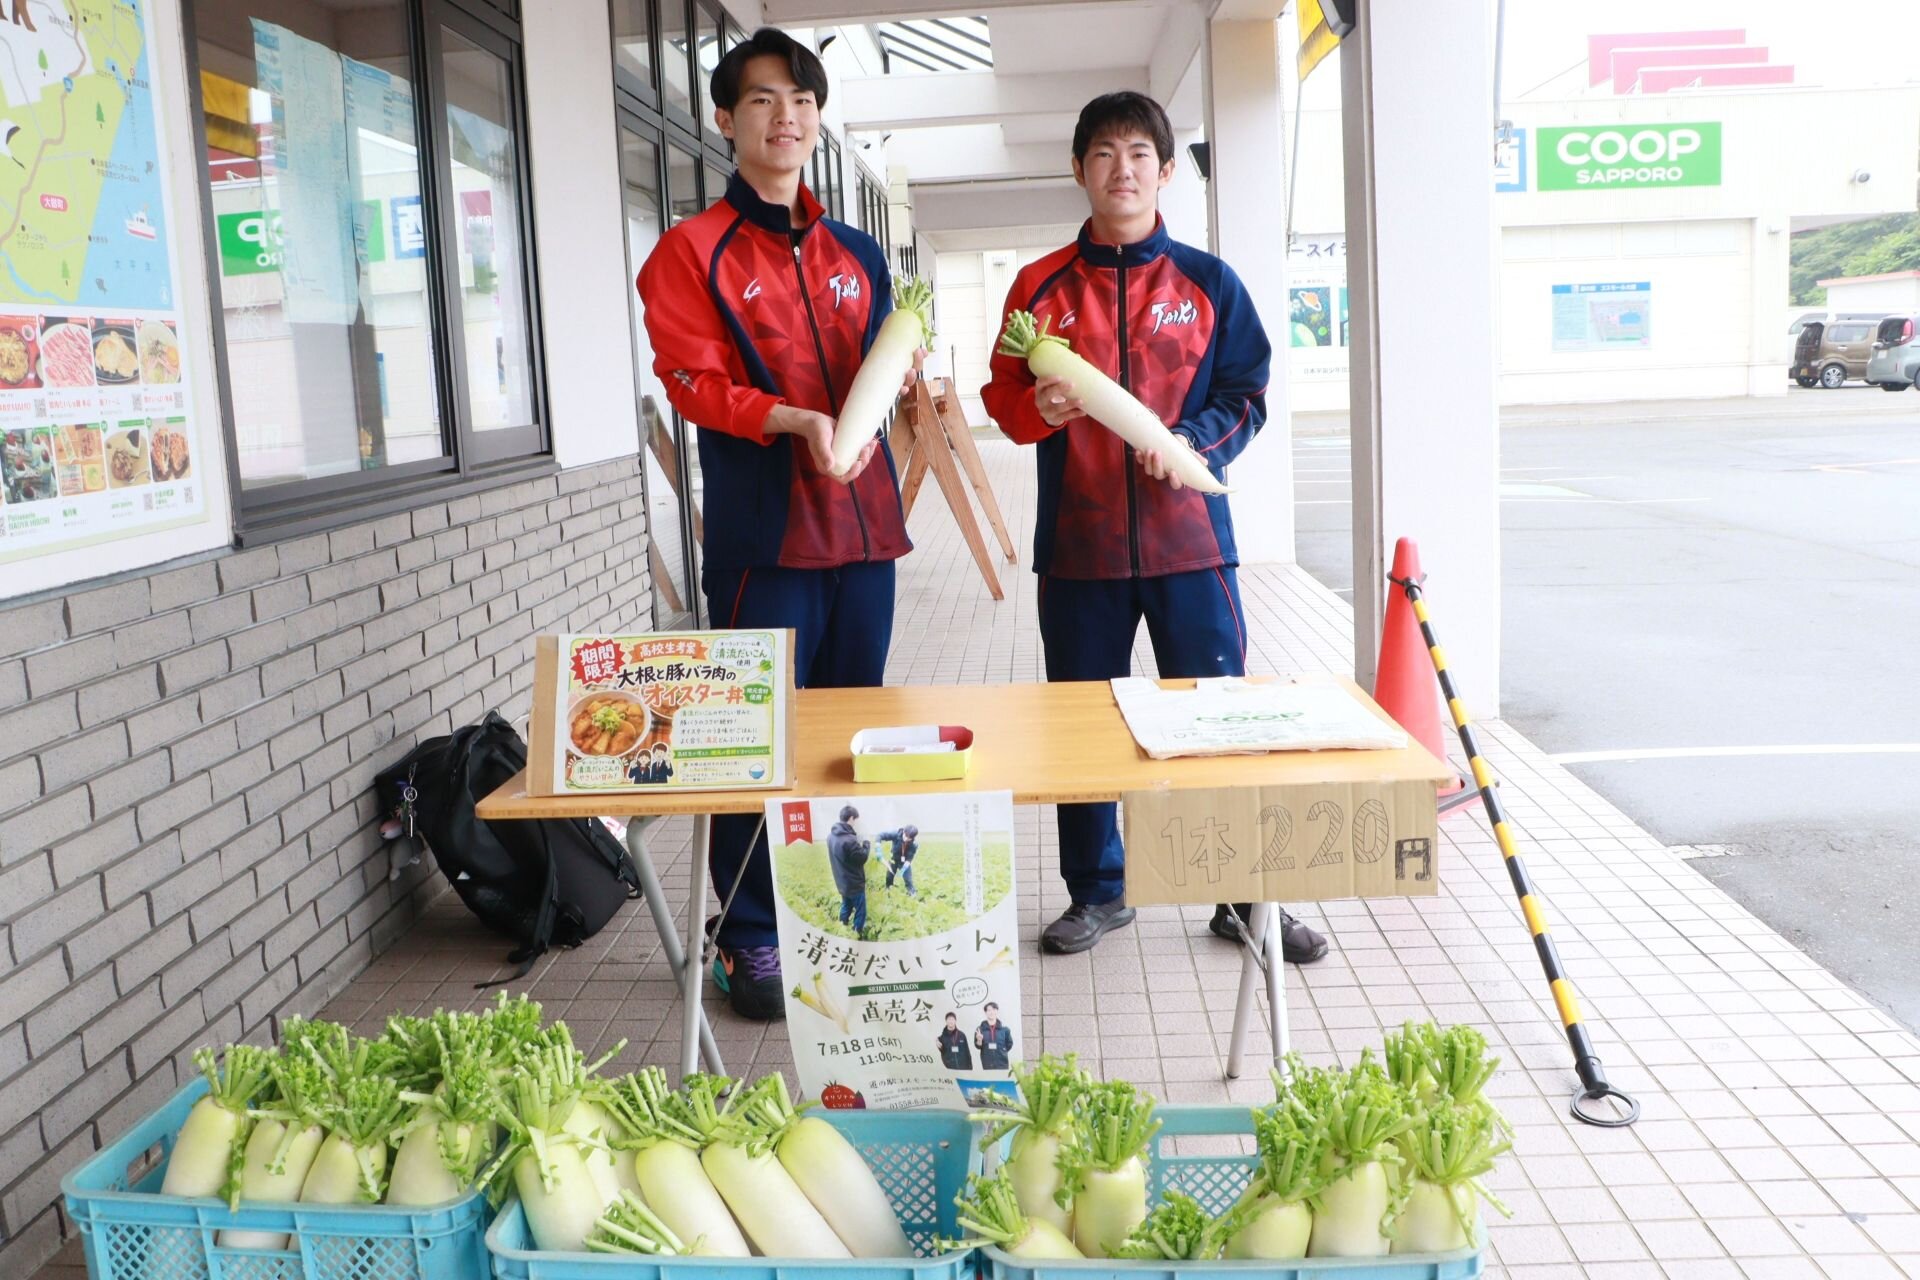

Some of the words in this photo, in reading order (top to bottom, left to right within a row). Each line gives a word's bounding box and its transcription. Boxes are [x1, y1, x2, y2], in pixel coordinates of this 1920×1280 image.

[1556, 128, 1701, 166] COOP
[1576, 166, 1683, 184] SAPPORO
[580, 645, 615, 665] 期間
[639, 640, 697, 657] 高校生考案
[715, 647, 768, 659] 清流だいこん
[585, 664, 616, 681] 限定
[736, 659, 751, 667] 使用
[617, 663, 737, 688] 大根と豚バラ肉の
[644, 683, 744, 706] オイスター丼
[797, 929, 997, 980] 清流だいこん
[867, 985, 892, 994] SEIRYU
[893, 983, 919, 992] DAIKON
[862, 998, 934, 1024] 直売会
